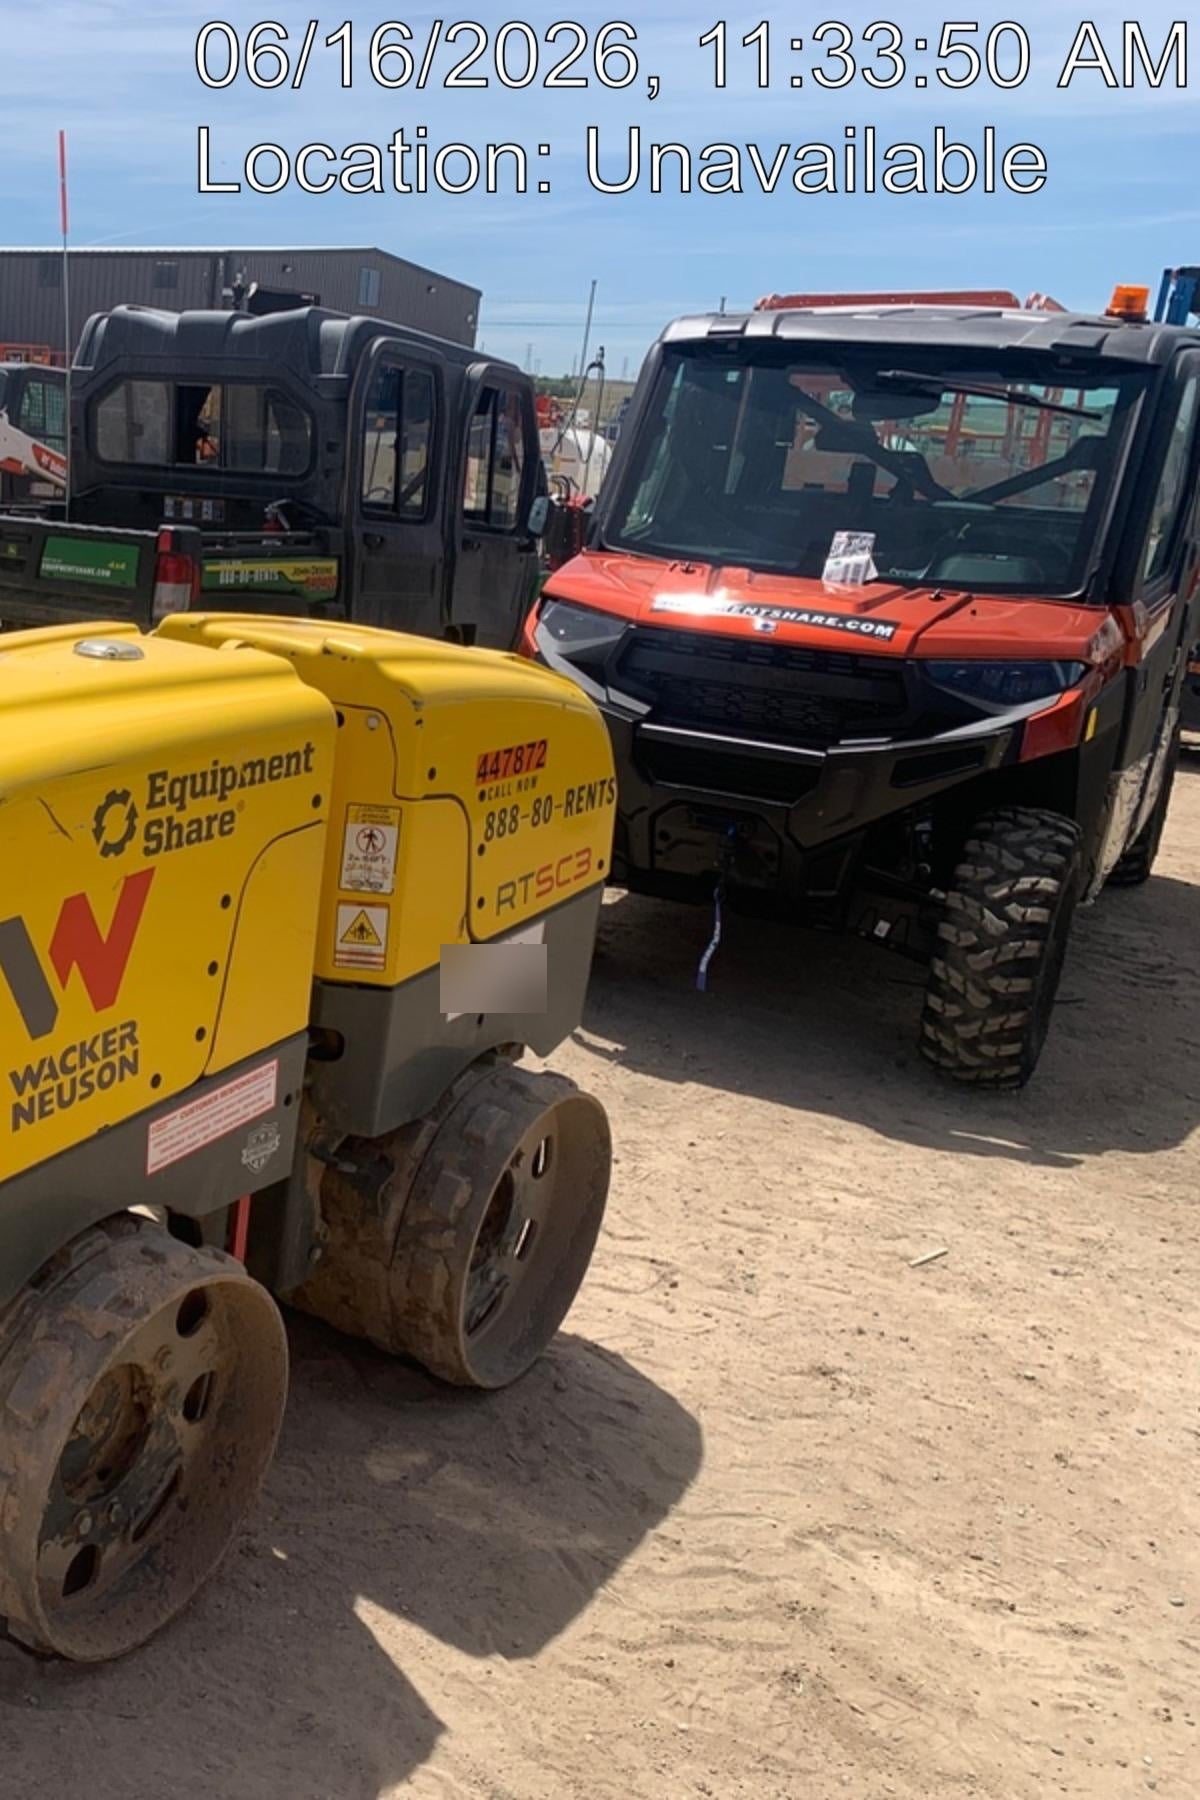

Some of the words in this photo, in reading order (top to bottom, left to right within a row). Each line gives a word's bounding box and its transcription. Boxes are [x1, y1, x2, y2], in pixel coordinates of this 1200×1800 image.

[145, 742, 315, 812] Equipment
[477, 739, 548, 781] 447872
[488, 782, 512, 801] CALL
[516, 775, 538, 793] NOW
[484, 777, 616, 842] 888-80-RENTS
[496, 847, 592, 916] RTSC3
[8, 1020, 139, 1096] WACKER
[11, 1047, 139, 1133] NEUSON
